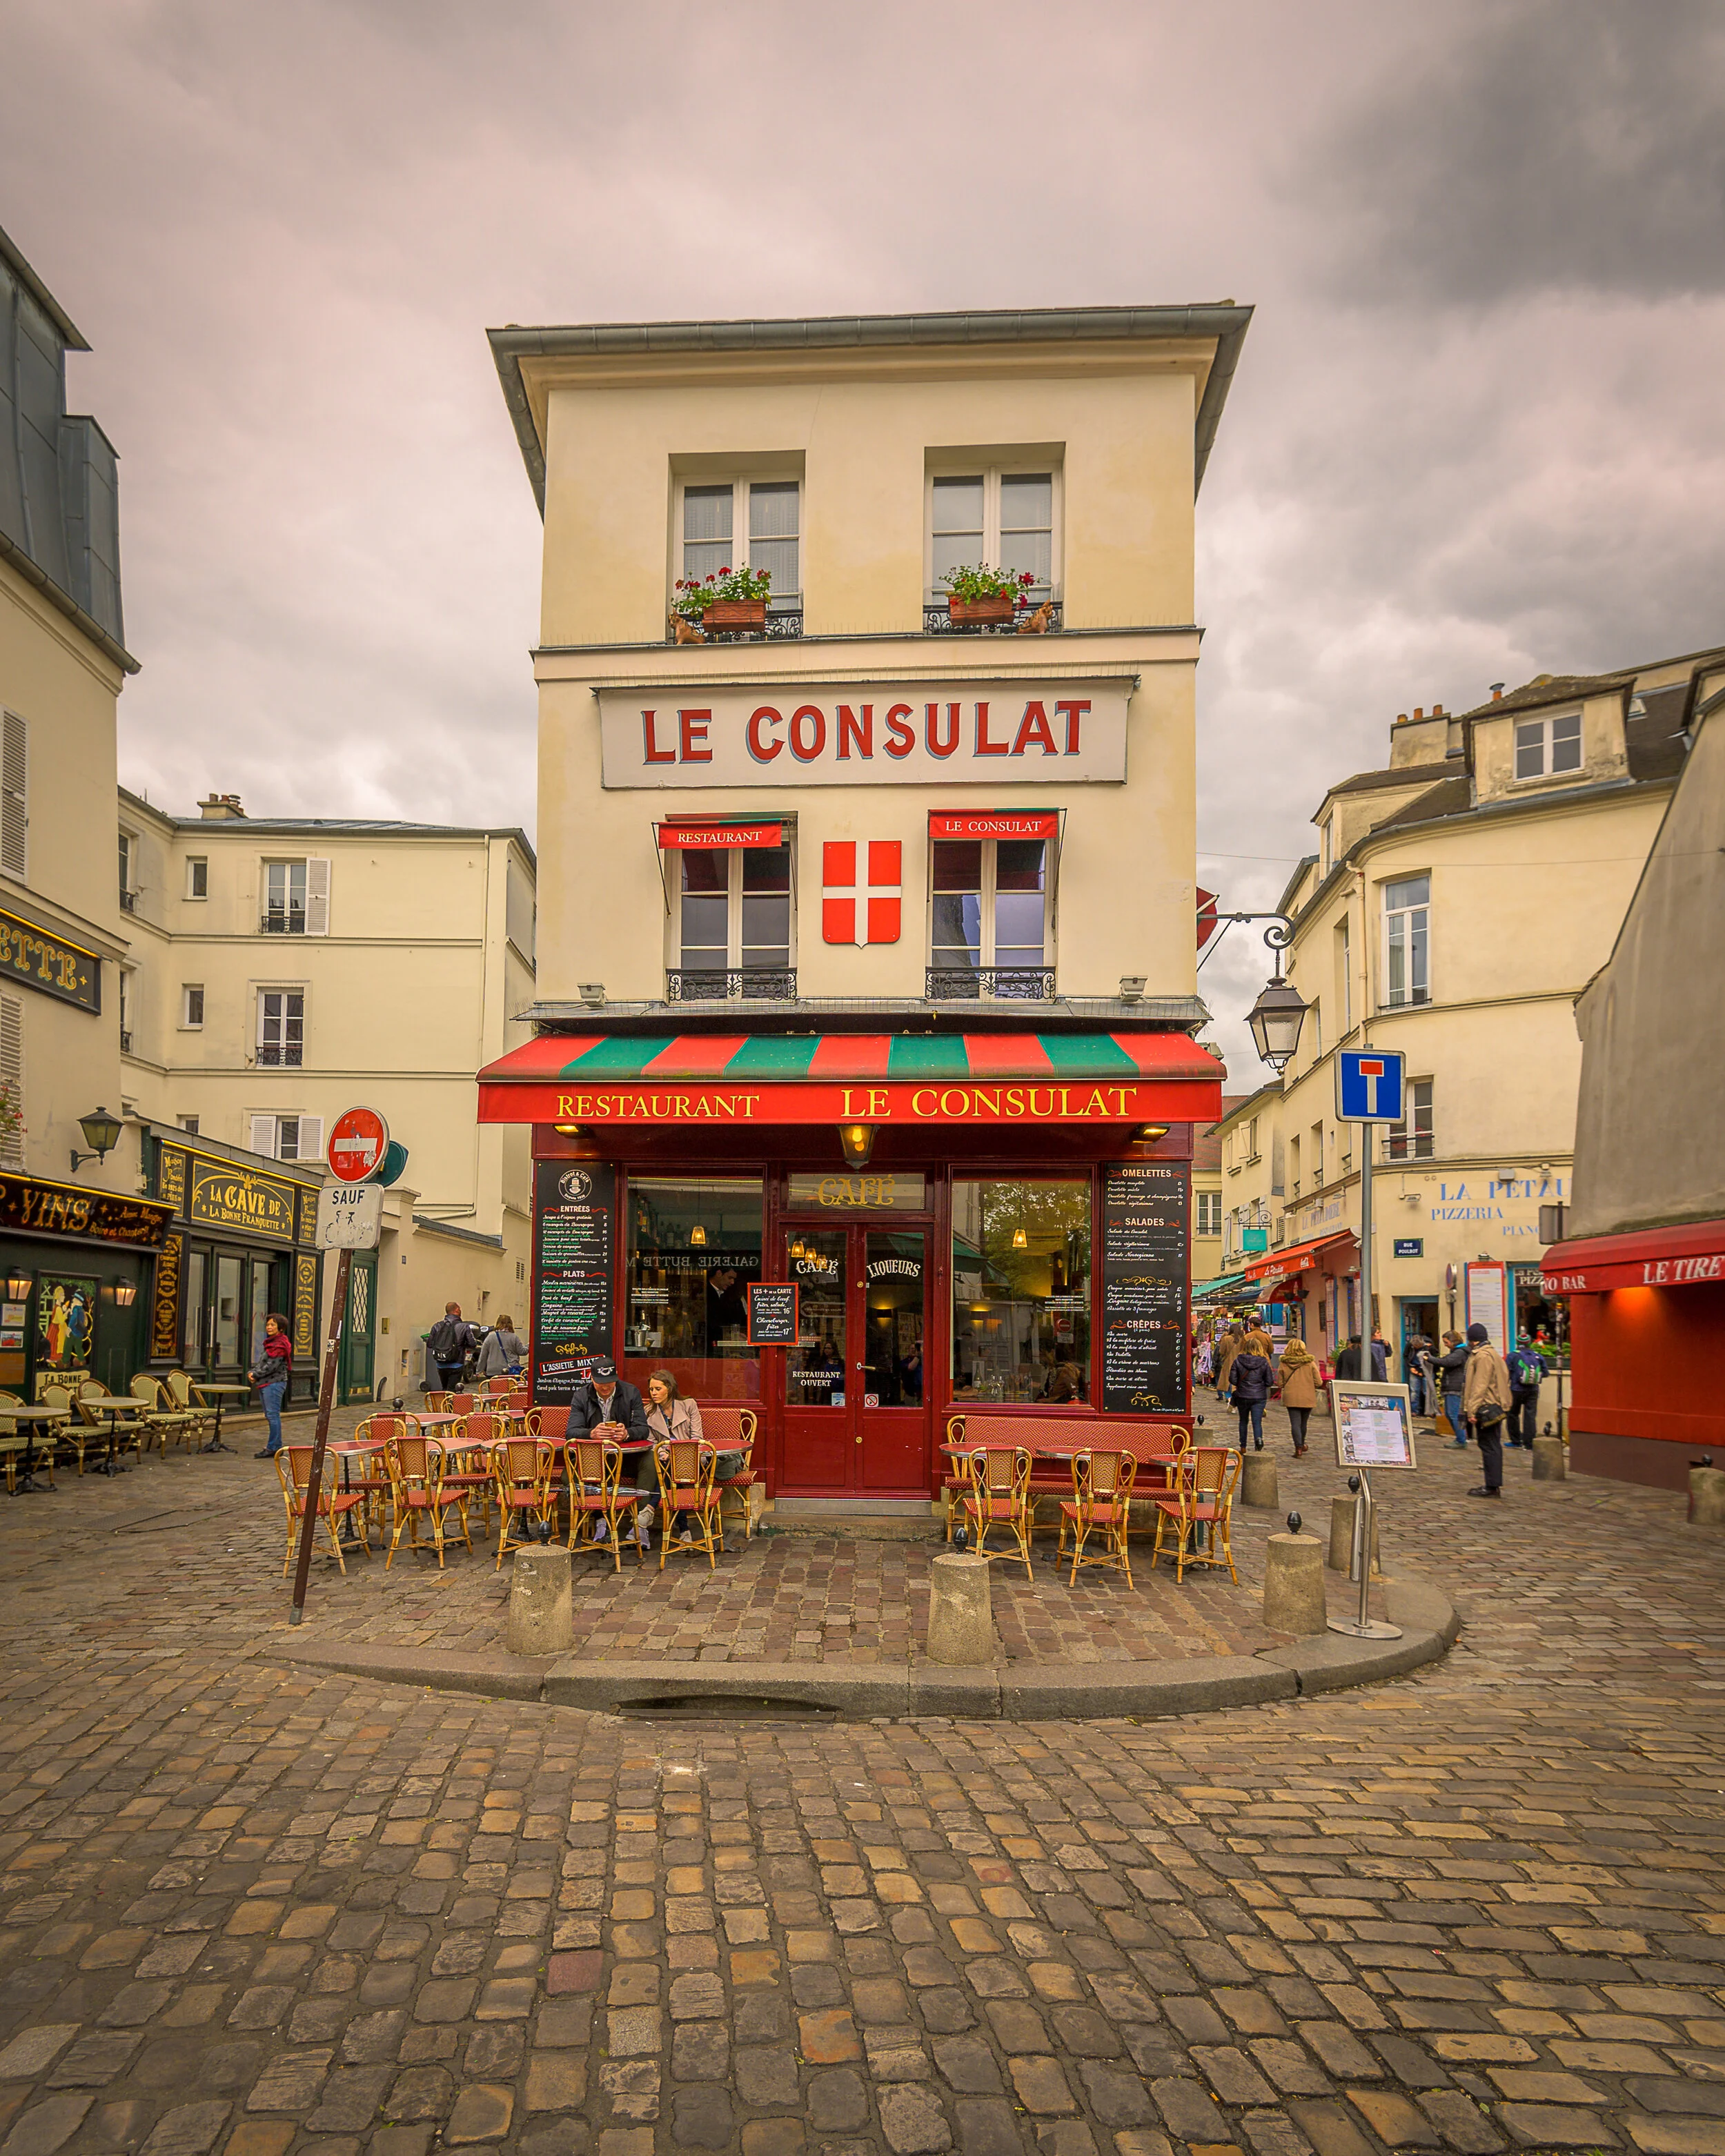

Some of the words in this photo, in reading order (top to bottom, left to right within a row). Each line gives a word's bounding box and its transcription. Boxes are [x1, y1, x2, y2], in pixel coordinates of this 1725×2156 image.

[641, 709, 713, 765] LE
[746, 700, 1092, 764] CONSULAT
[945, 820, 962, 832] LE
[968, 820, 1041, 833] CONSULAT
[678, 830, 762, 843] RESTAURANT
[557, 1095, 759, 1118] RESTAURANT
[840, 1089, 890, 1118] LE
[911, 1087, 1137, 1117] CONSULAT
[560, 1171, 575, 1184] Bistrot
[1122, 1169, 1172, 1177] OMELETTES
[332, 1189, 365, 1205] SAUF
[818, 1174, 895, 1206] CAFÉ
[1440, 1183, 1471, 1200] LA
[210, 1185, 222, 1203] LA
[225, 1185, 266, 1216] CAVE
[269, 1200, 280, 1216] DE
[21, 1189, 89, 1231] VINS
[1432, 1207, 1504, 1220] PIZZERIA
[221, 1208, 241, 1221] BONNE
[242, 1212, 279, 1229] FRANQUETTE
[1125, 1218, 1165, 1226] SALADES
[796, 1258, 839, 1274] CAFÉ
[867, 1259, 921, 1278] LIQUEURS
[1643, 1261, 1670, 1284] LE
[1673, 1256, 1725, 1280] TIRE
[1562, 1275, 1586, 1289] BAR
[1127, 1320, 1161, 1328] CRÊPES
[542, 1361, 574, 1372] L'ASSIETTE
[58, 1374, 81, 1383] BONNE
